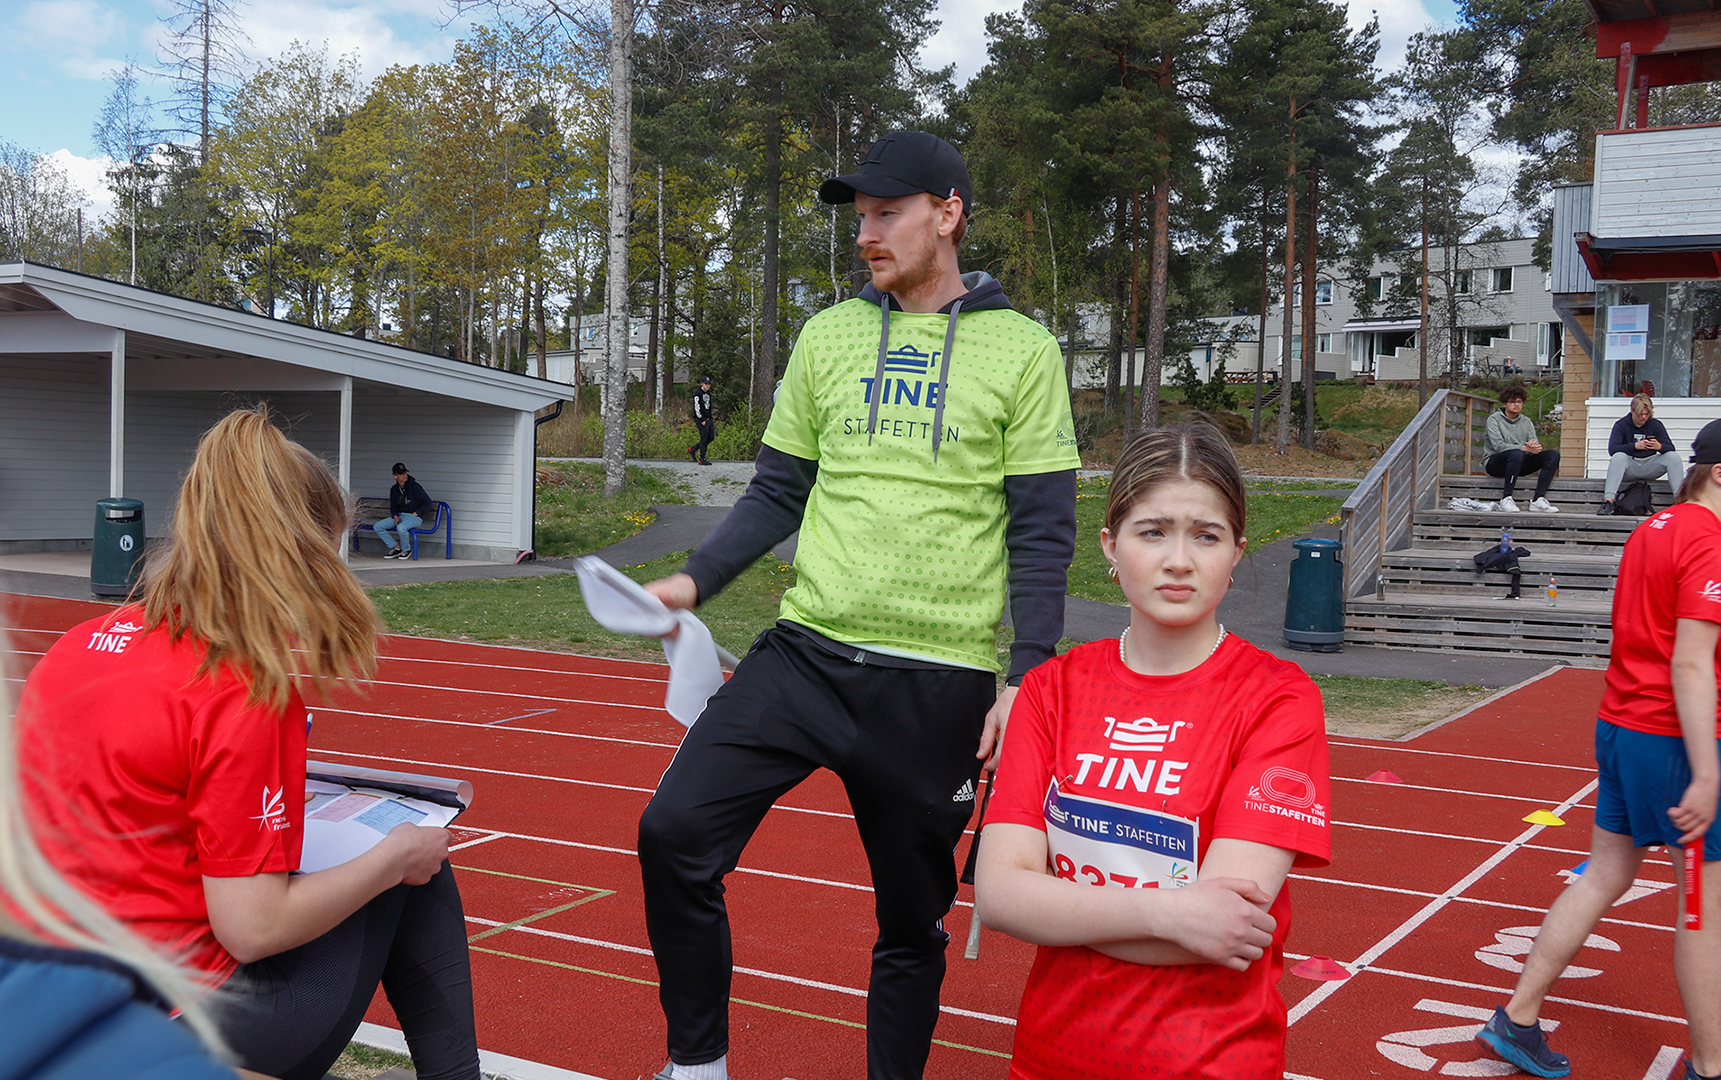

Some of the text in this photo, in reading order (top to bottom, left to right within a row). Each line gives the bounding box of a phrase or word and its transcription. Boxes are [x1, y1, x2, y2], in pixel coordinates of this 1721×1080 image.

[859, 377, 949, 410] TINE
[844, 418, 959, 443] STFETTN
[86, 632, 132, 653] TINE
[1073, 753, 1189, 796] TINE
[952, 792, 975, 802] adida
[1244, 800, 1325, 828] TINESTAFETTEN
[1310, 807, 1326, 818] TINE
[1071, 815, 1186, 852] TINE STAFETTEN
[1055, 853, 1159, 888] 83
